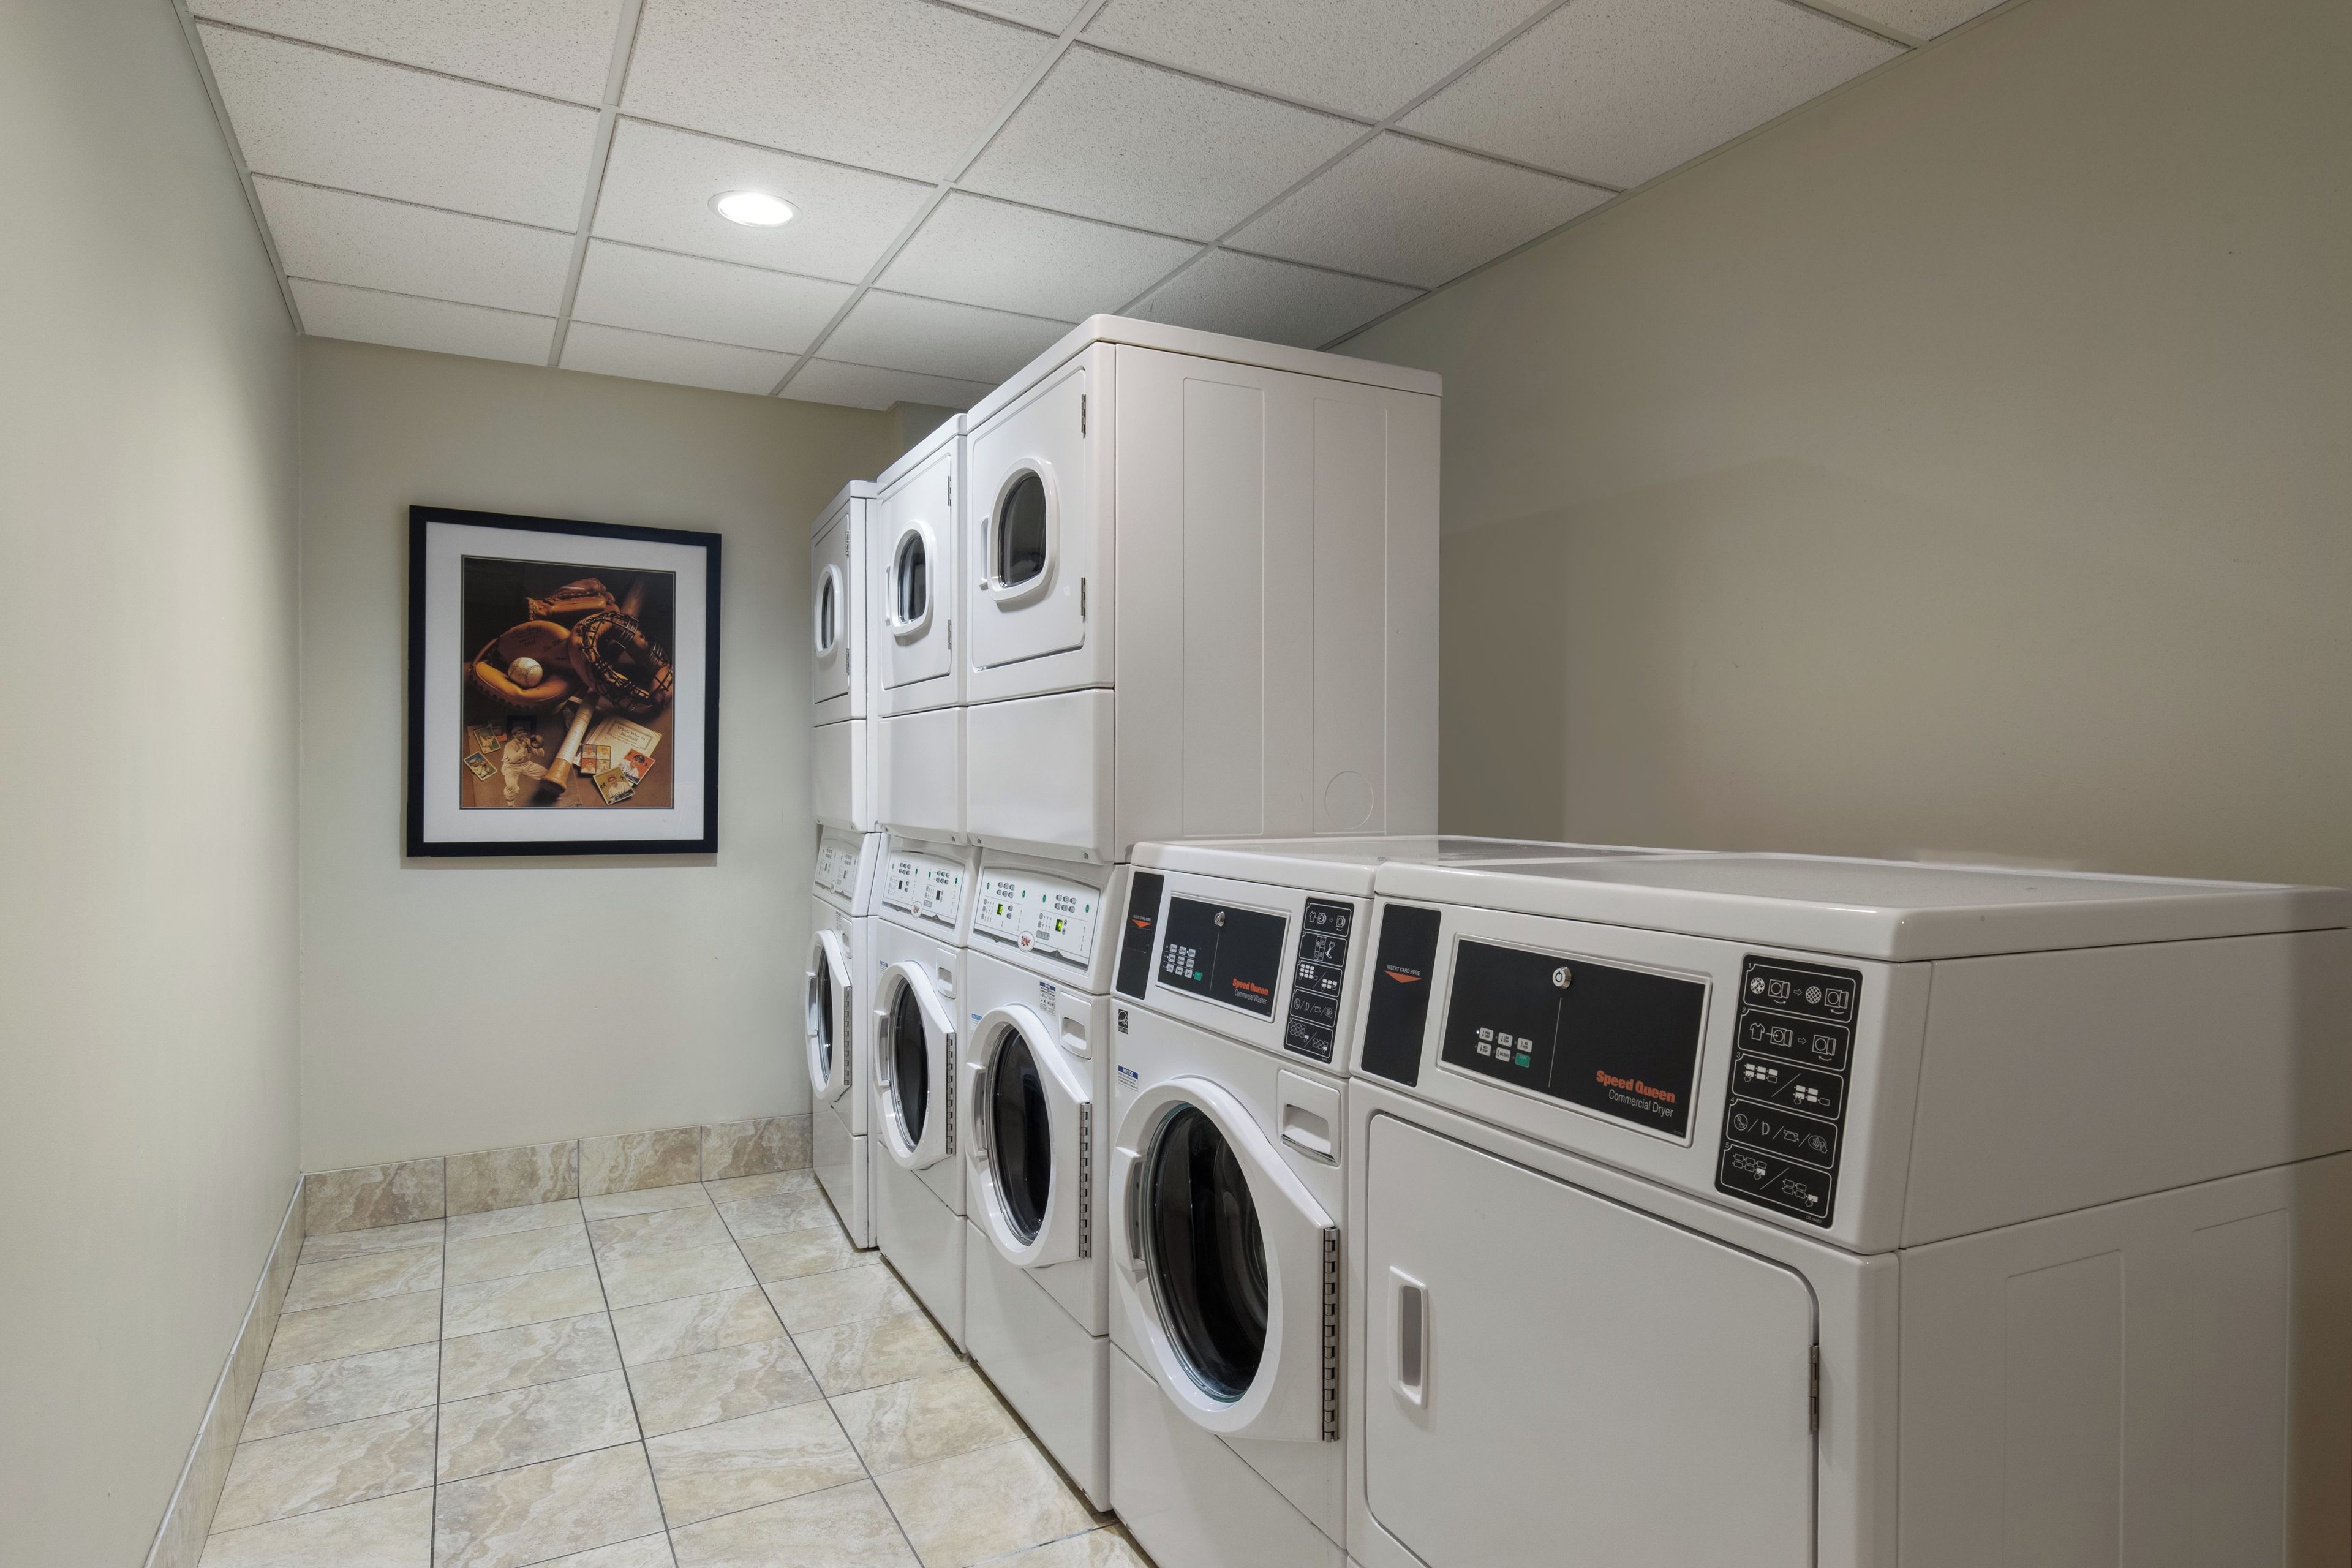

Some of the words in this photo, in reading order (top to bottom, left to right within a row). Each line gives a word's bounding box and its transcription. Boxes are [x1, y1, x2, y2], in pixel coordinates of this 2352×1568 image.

[1232, 978, 1250, 990] Speed
[1250, 983, 1268, 995] Queen
[1235, 989, 1254, 1001] Commercial
[1254, 995, 1267, 1005] Washer
[1123, 1068, 1133, 1077] NOTICE
[1596, 1069, 1634, 1091] Speed
[1635, 1080, 1676, 1104] Queen
[1608, 1088, 1651, 1110] Commercial
[1652, 1102, 1674, 1118] Dryer
